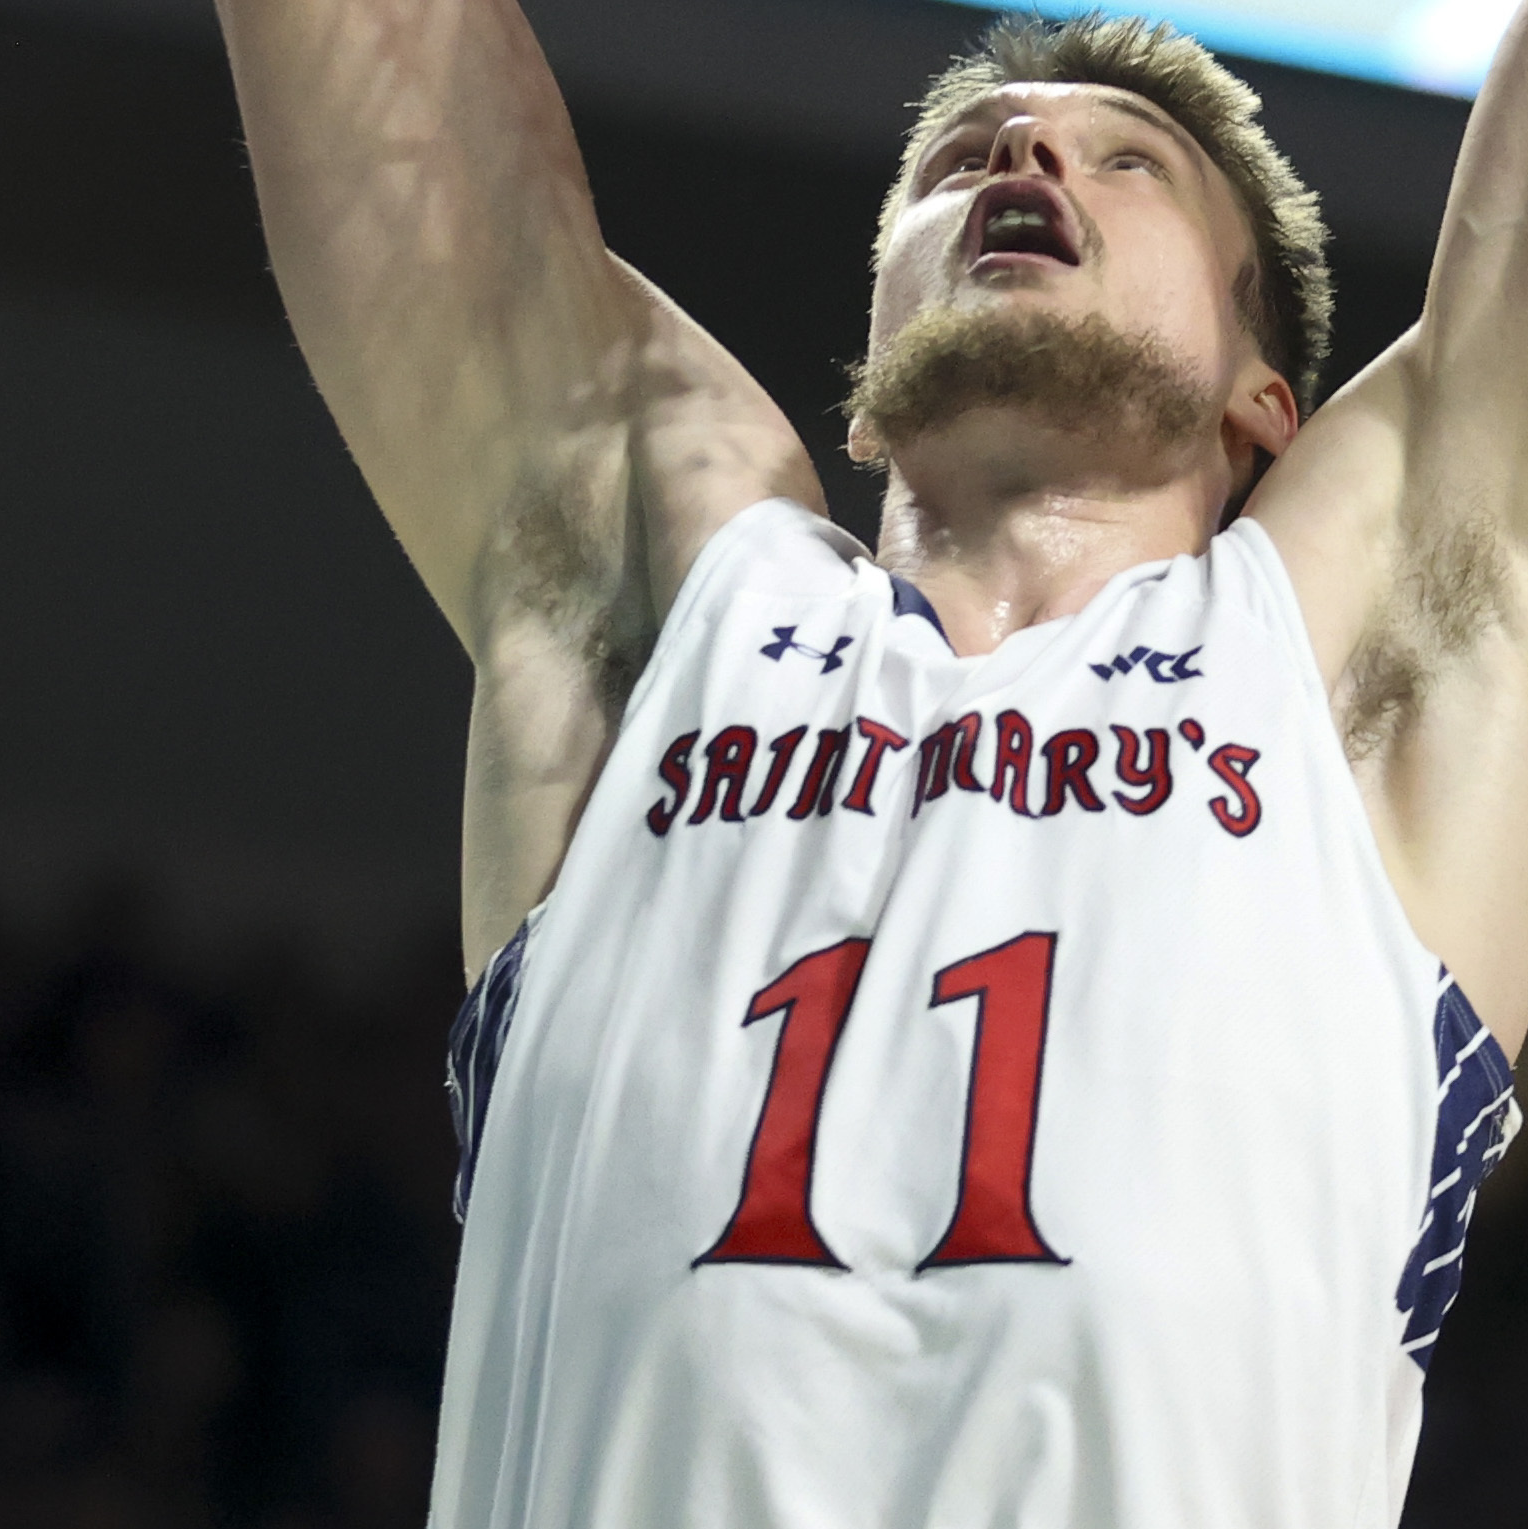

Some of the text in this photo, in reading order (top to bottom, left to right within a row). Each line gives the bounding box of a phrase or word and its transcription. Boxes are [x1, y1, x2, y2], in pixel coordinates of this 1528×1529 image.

[1087, 643, 1205, 684] WCC
[645, 708, 1263, 839] SAINT MARY'S
[690, 930, 1073, 1280] 11
